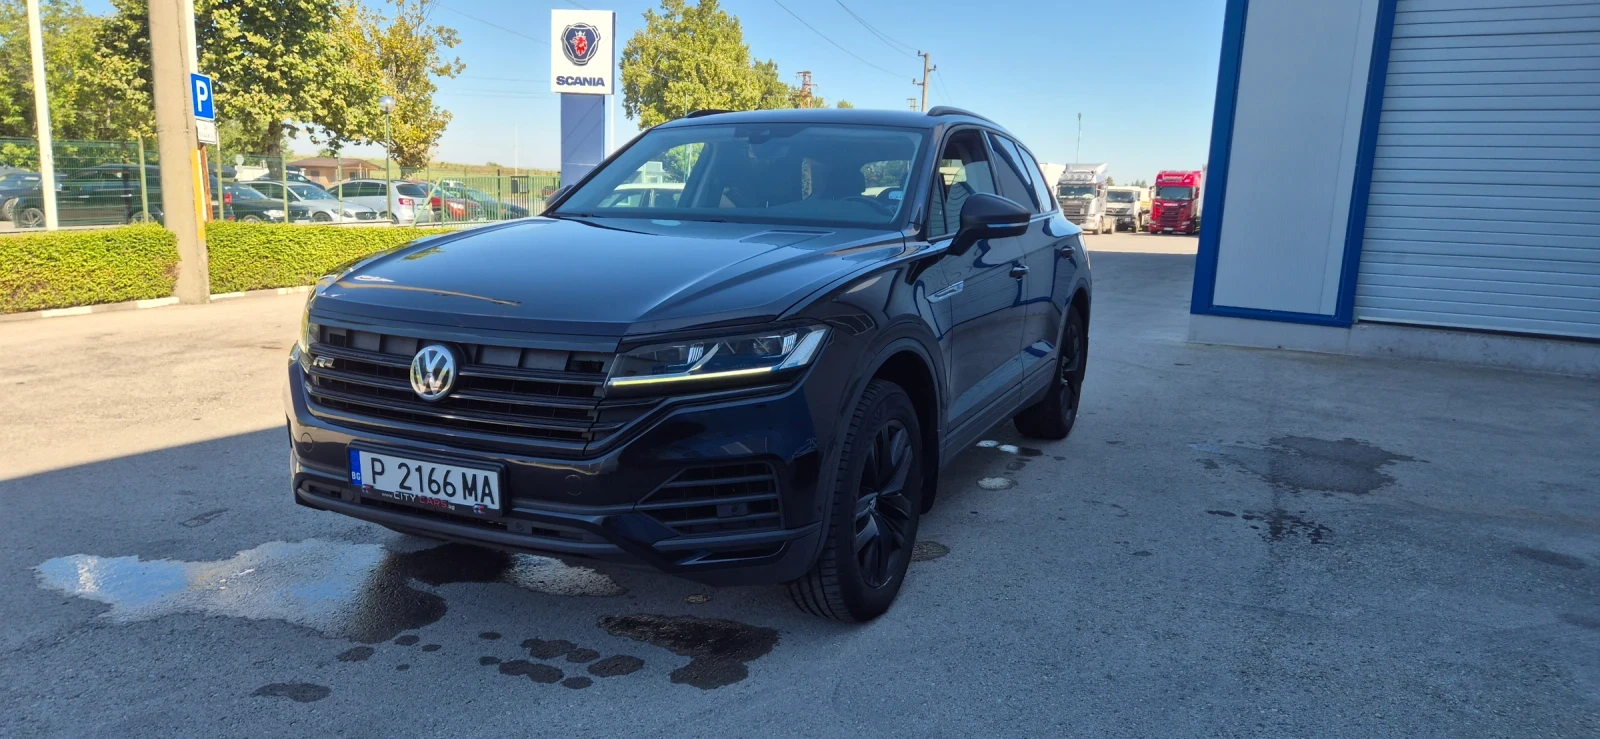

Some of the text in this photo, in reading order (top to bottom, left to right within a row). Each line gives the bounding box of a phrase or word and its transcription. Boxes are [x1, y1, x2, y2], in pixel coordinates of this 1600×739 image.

[556, 75, 605, 87] SCANIA
[195, 79, 209, 113] P
[351, 471, 361, 480] BG
[370, 457, 496, 505] P 2166 MA
